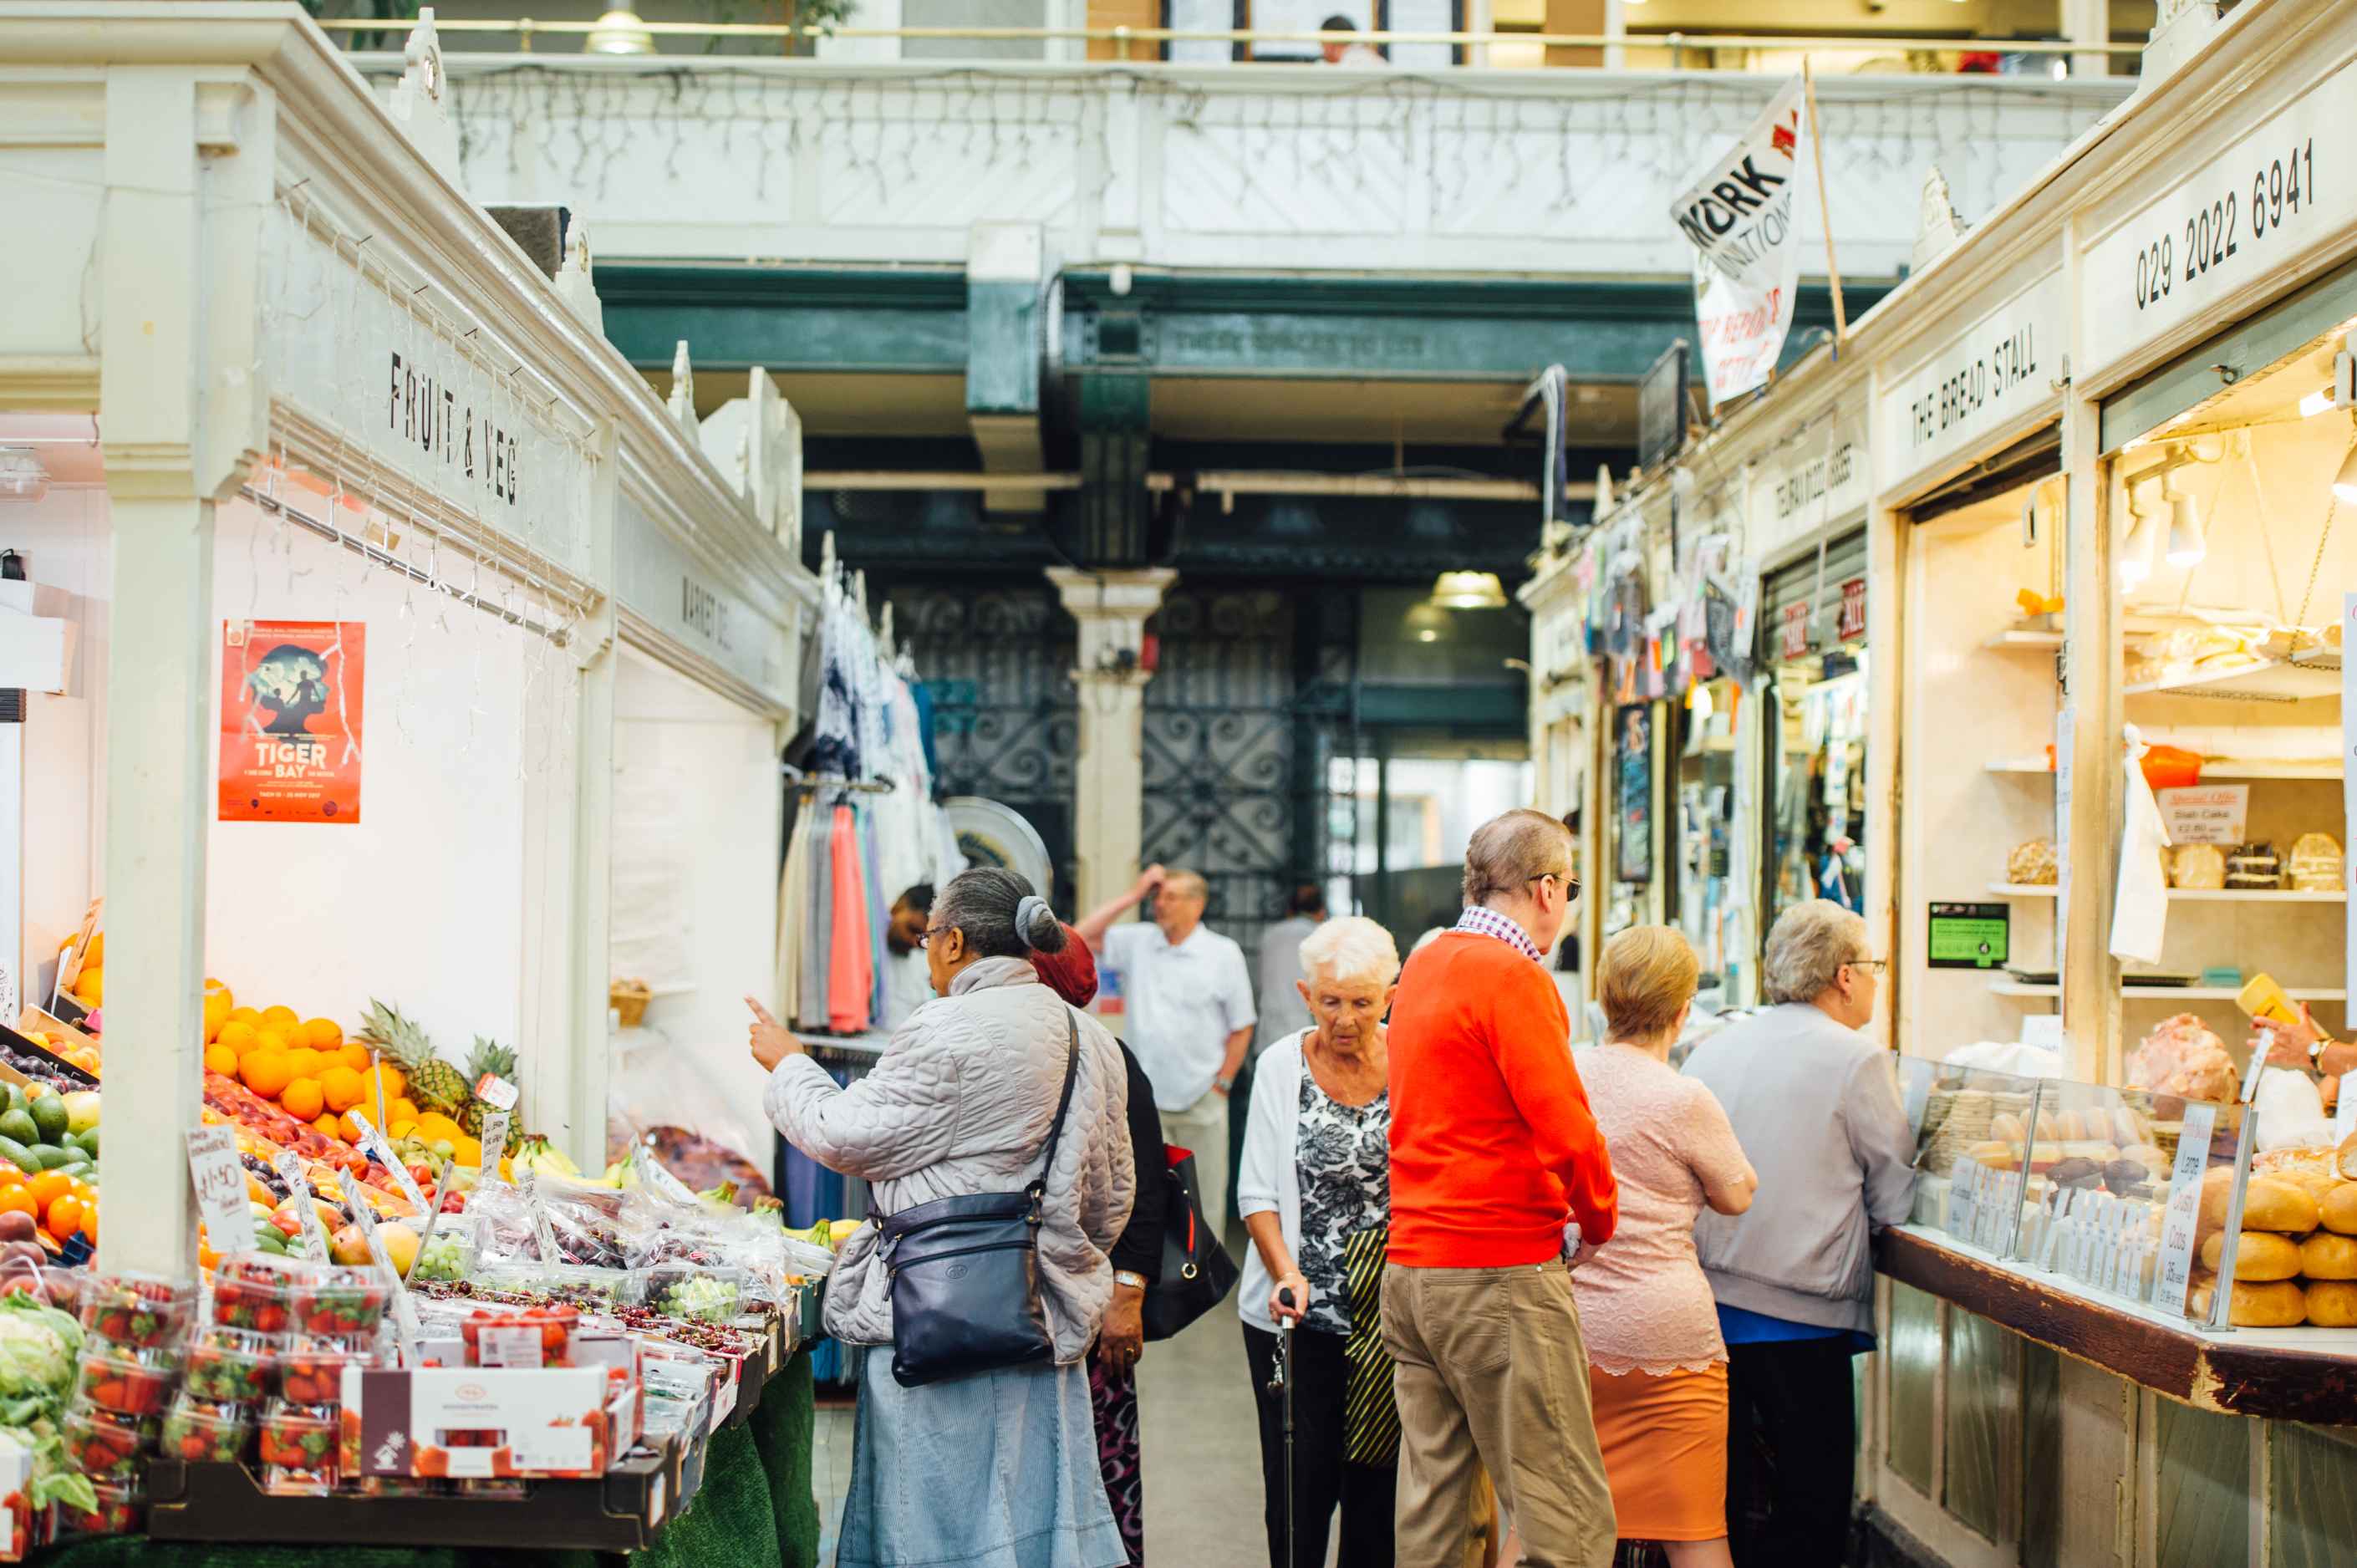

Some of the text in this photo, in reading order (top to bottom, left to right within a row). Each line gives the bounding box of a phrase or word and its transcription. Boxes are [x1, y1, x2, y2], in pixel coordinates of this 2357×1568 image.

[2136, 137, 2313, 310] 029 2022 6941
[390, 351, 516, 506] FRUIT & VEG
[1912, 322, 2036, 448] THE BREAD STALL
[254, 742, 328, 770] TIGER
[274, 764, 307, 778] BAY
